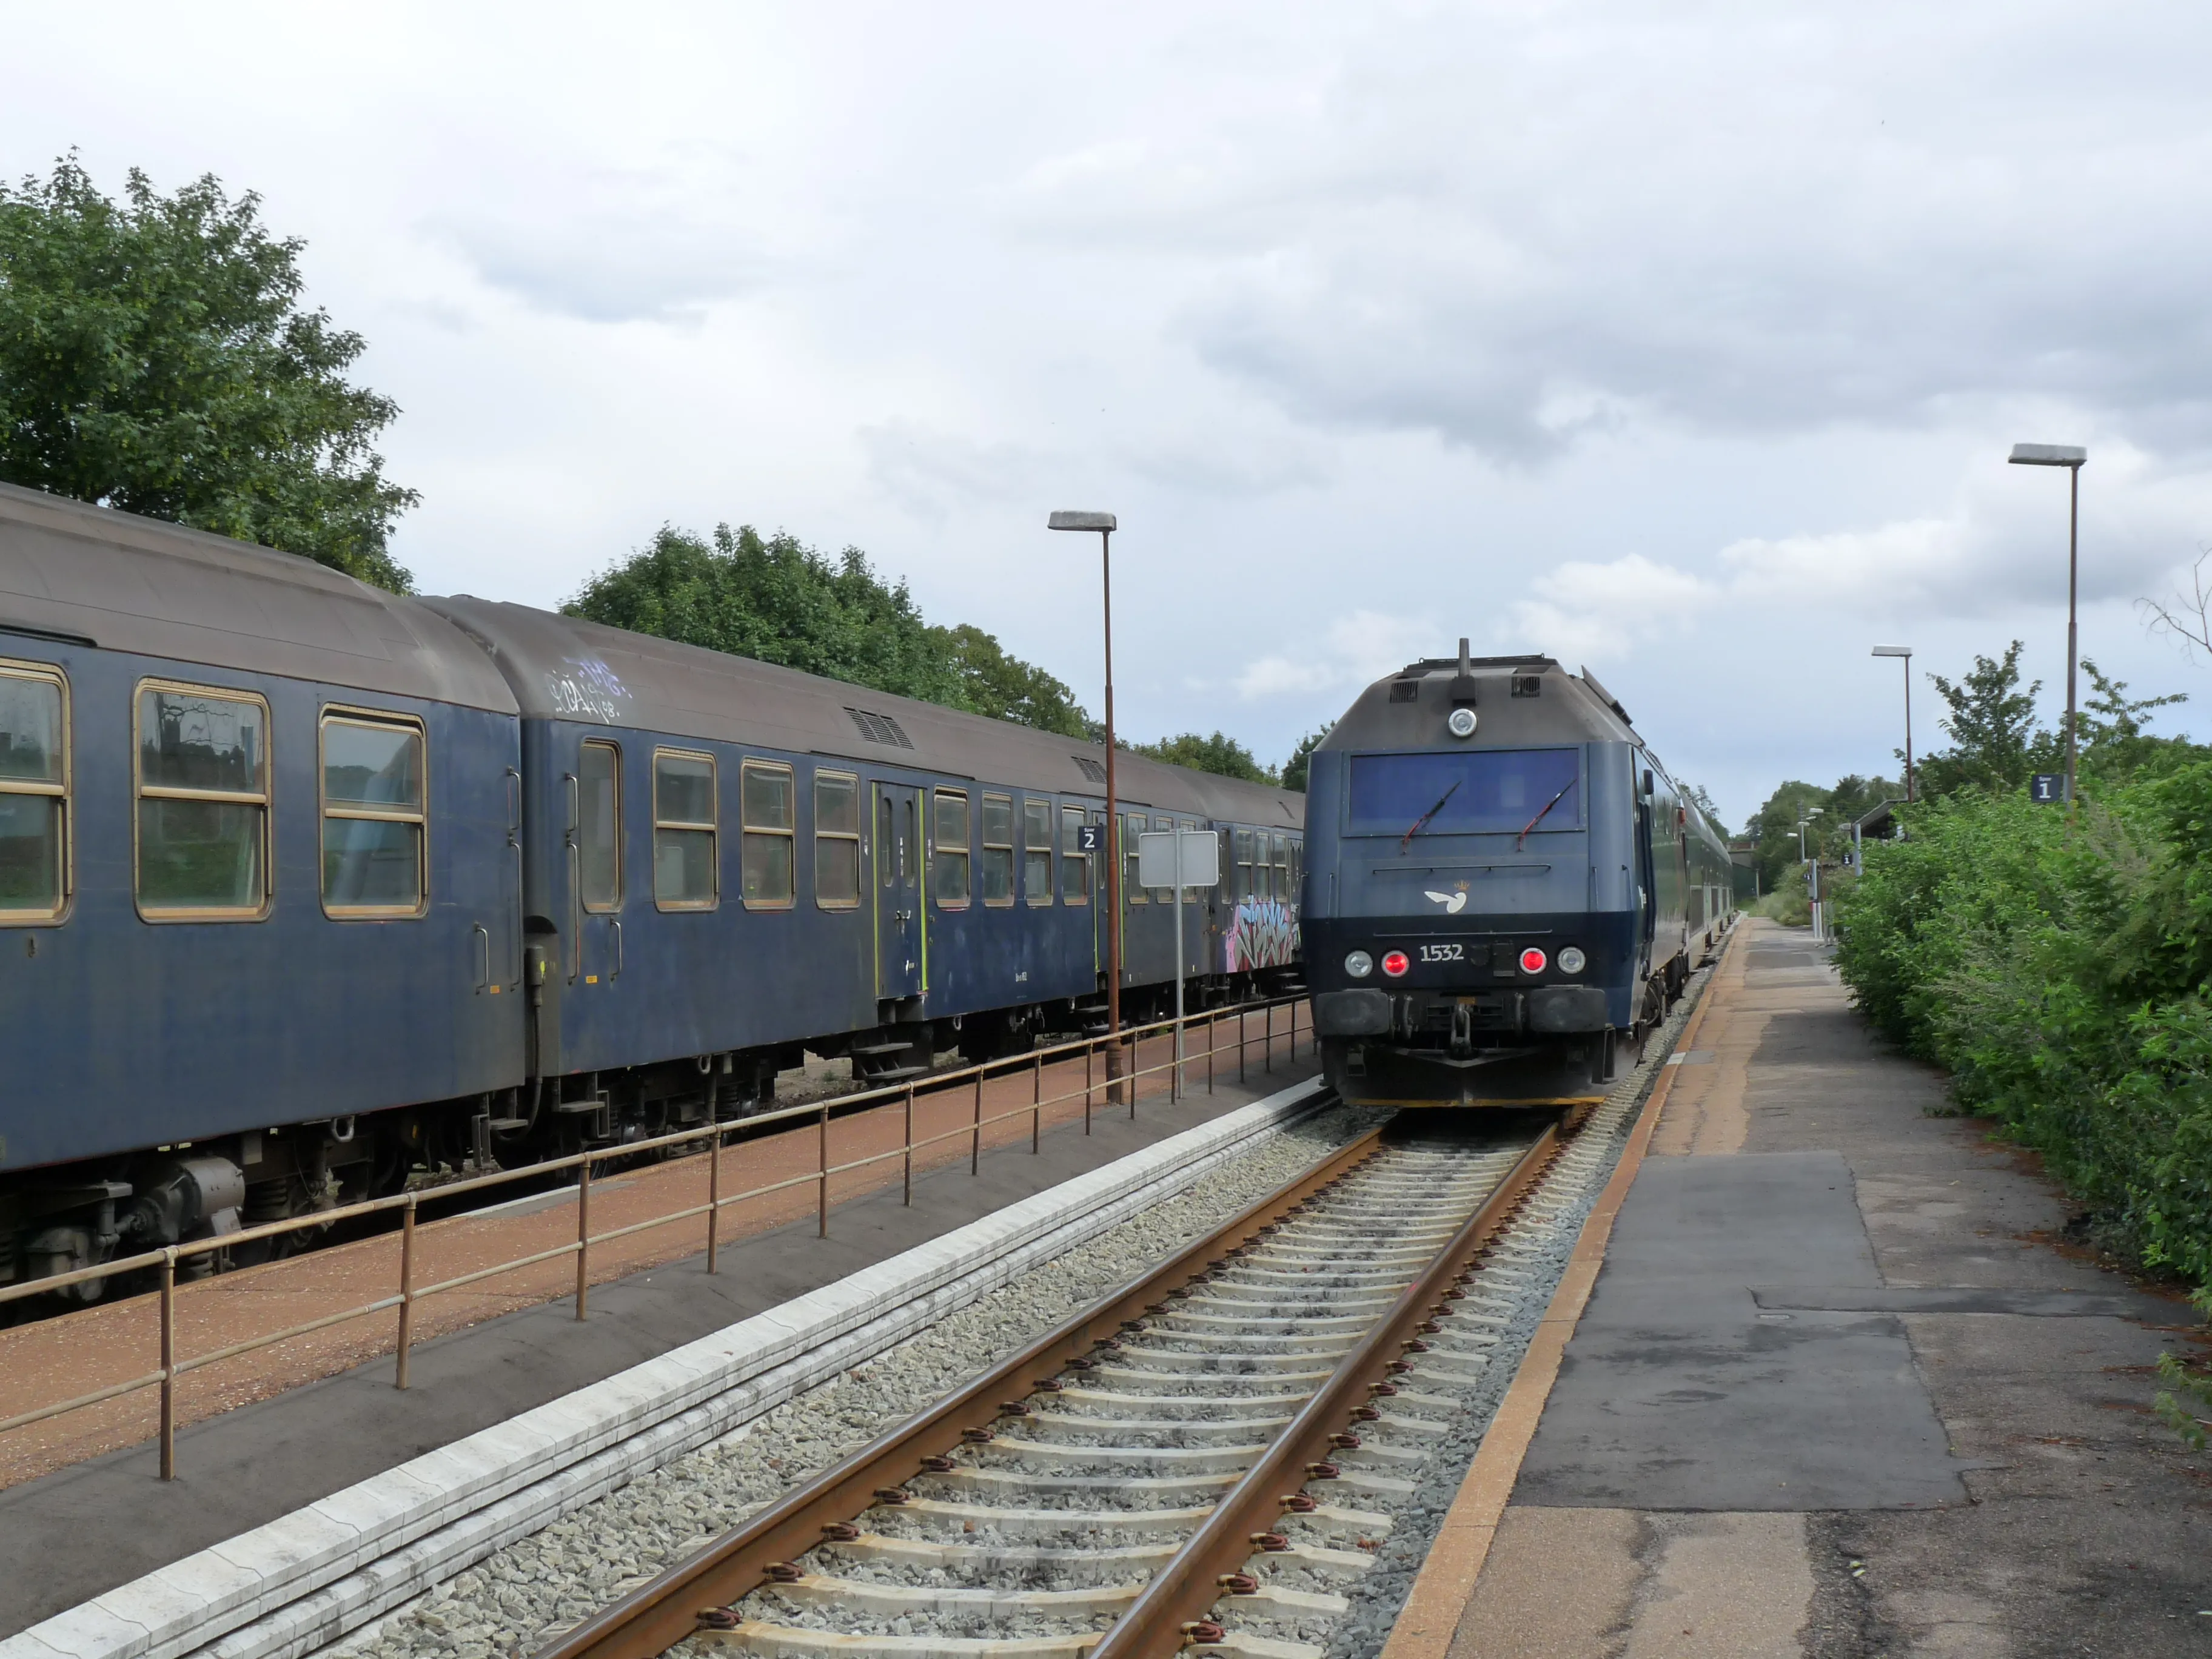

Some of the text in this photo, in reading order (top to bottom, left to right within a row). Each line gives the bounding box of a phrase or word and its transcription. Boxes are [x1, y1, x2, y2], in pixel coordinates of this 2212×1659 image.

[2039, 783, 2051, 799] 1
[1085, 833, 1094, 848] 2
[1420, 944, 1464, 961] 1532
